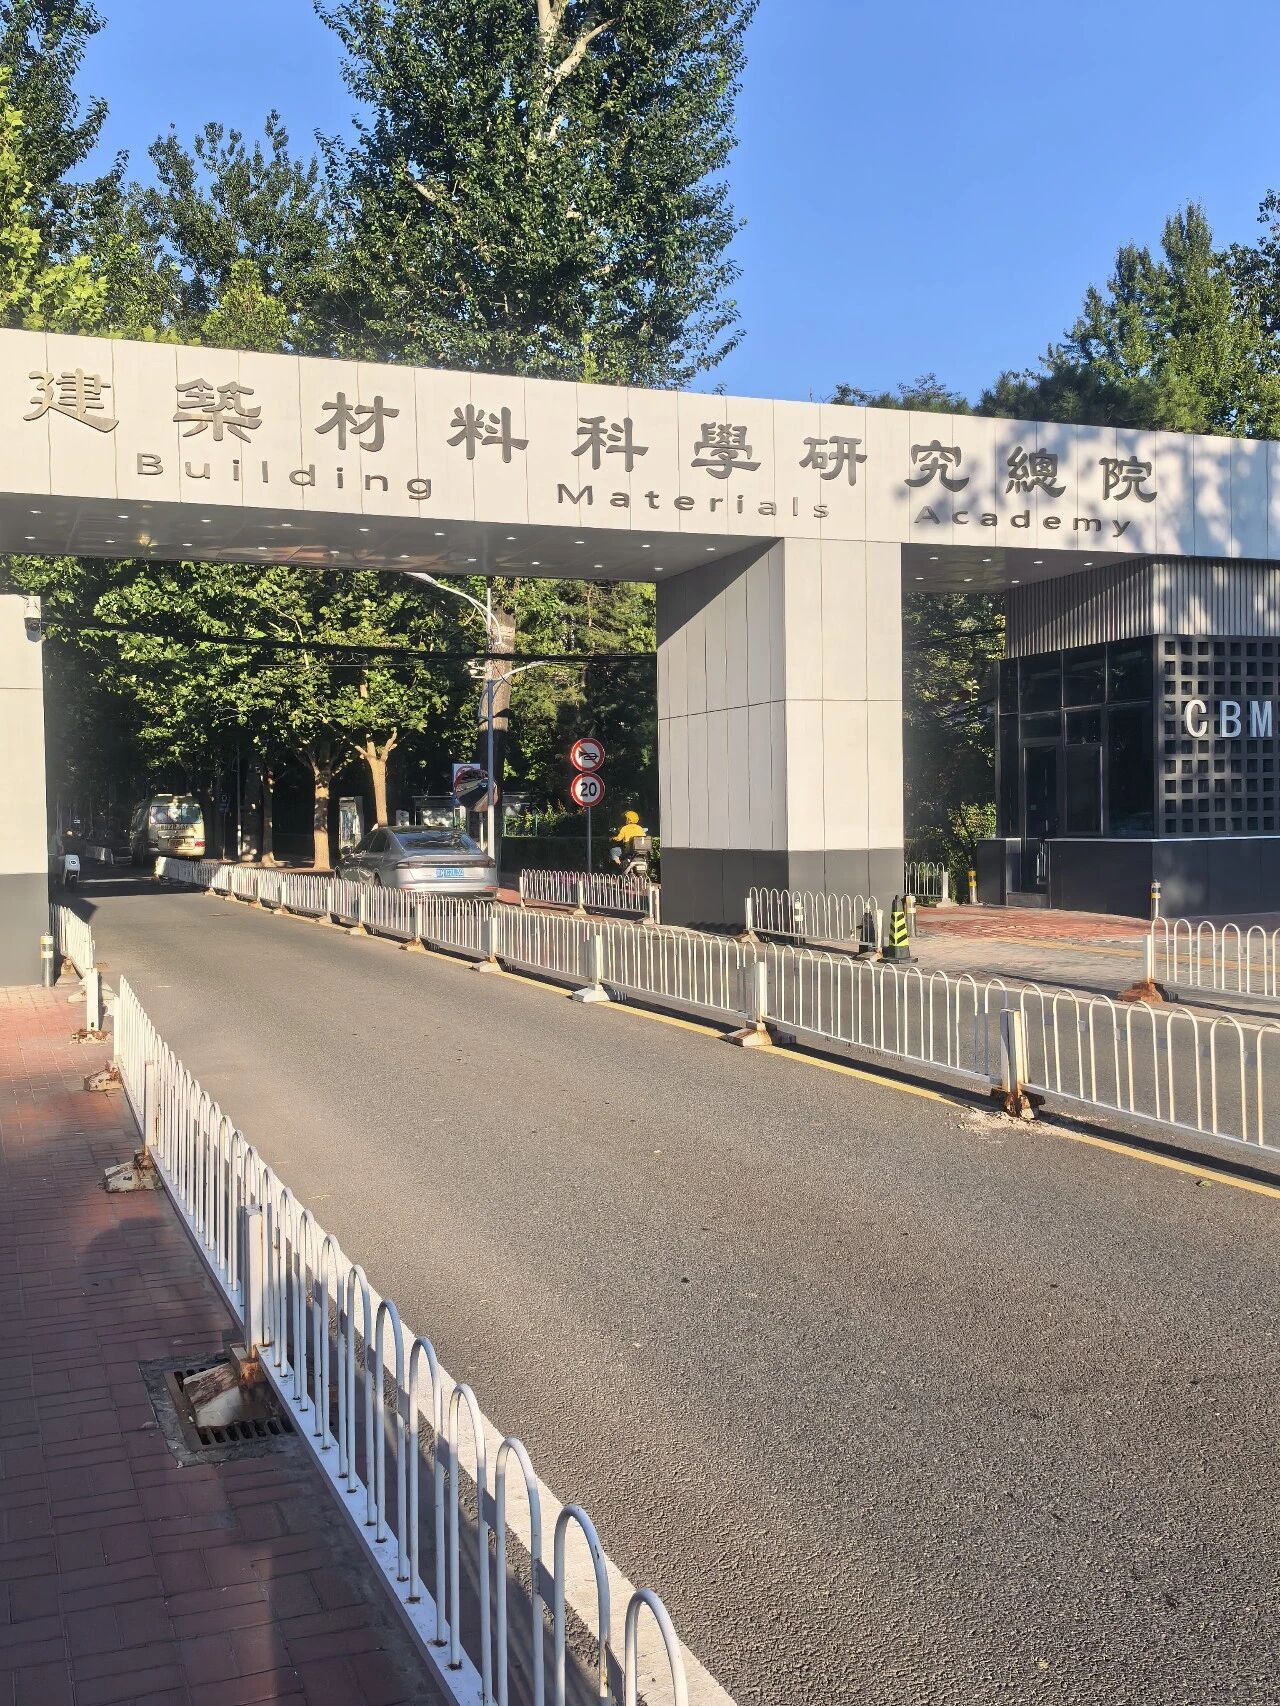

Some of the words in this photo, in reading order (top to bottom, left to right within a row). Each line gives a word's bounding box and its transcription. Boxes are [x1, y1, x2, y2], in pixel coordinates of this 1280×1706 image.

[136, 453, 432, 500] Building
[557, 483, 830, 519] Materials
[915, 505, 1132, 538] Academy
[1184, 699, 1273, 738] CBM
[580, 782, 597, 797] 20
